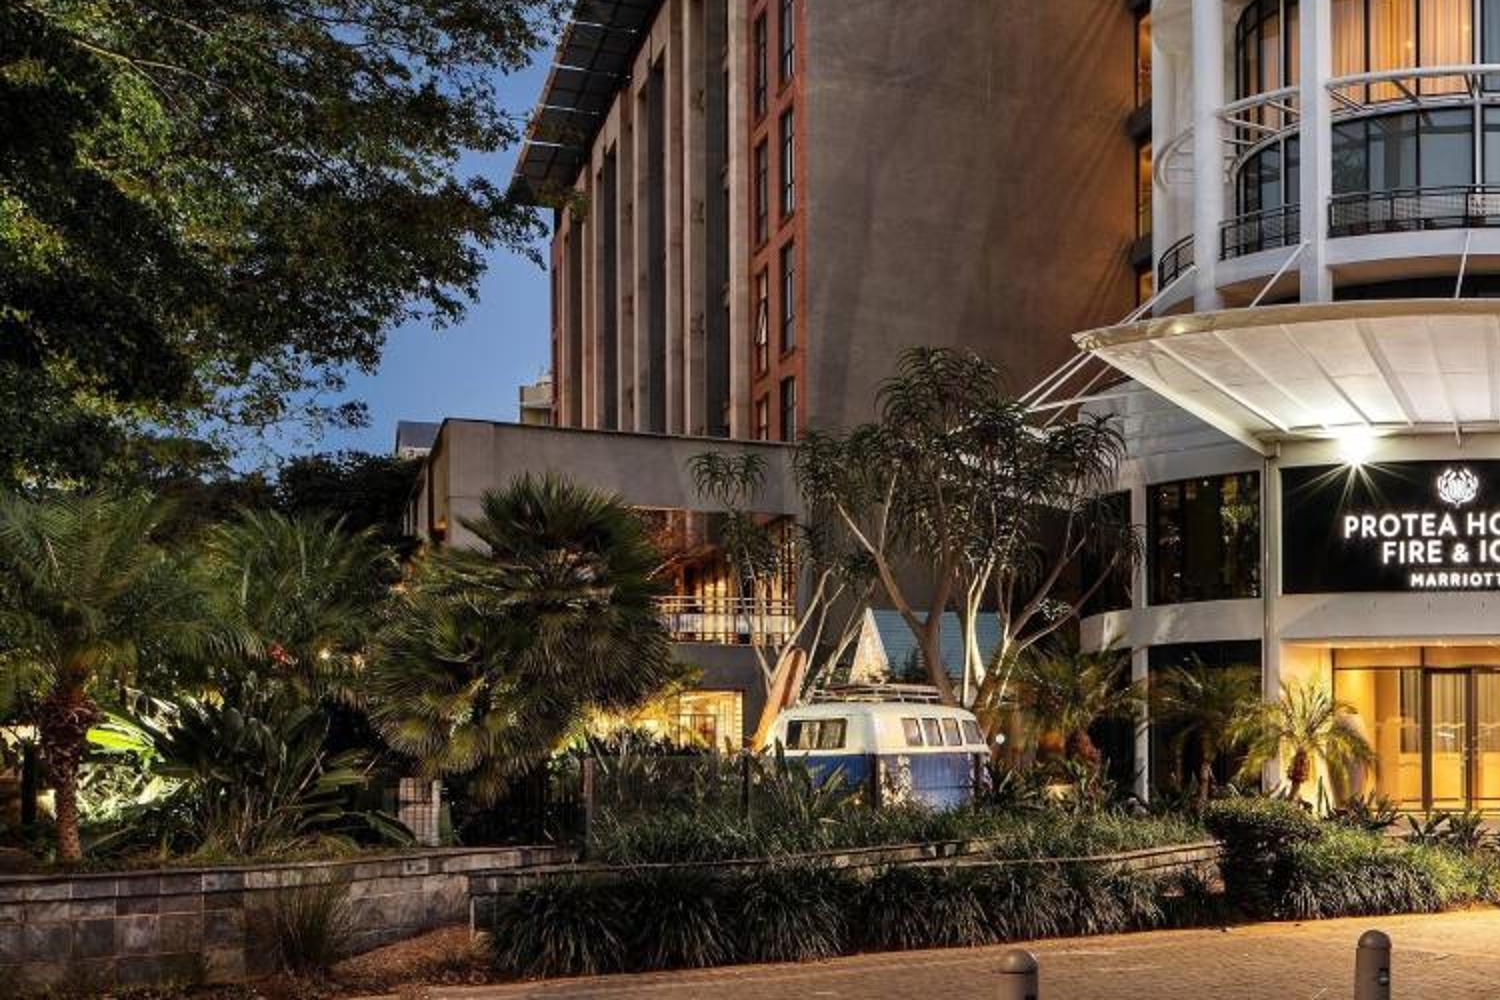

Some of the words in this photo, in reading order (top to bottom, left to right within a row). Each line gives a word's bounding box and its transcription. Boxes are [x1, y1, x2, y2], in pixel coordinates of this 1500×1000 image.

[1343, 513, 1458, 539] PROTEA
[1382, 540, 1443, 564] FIRE
[1452, 543, 1470, 563] &
